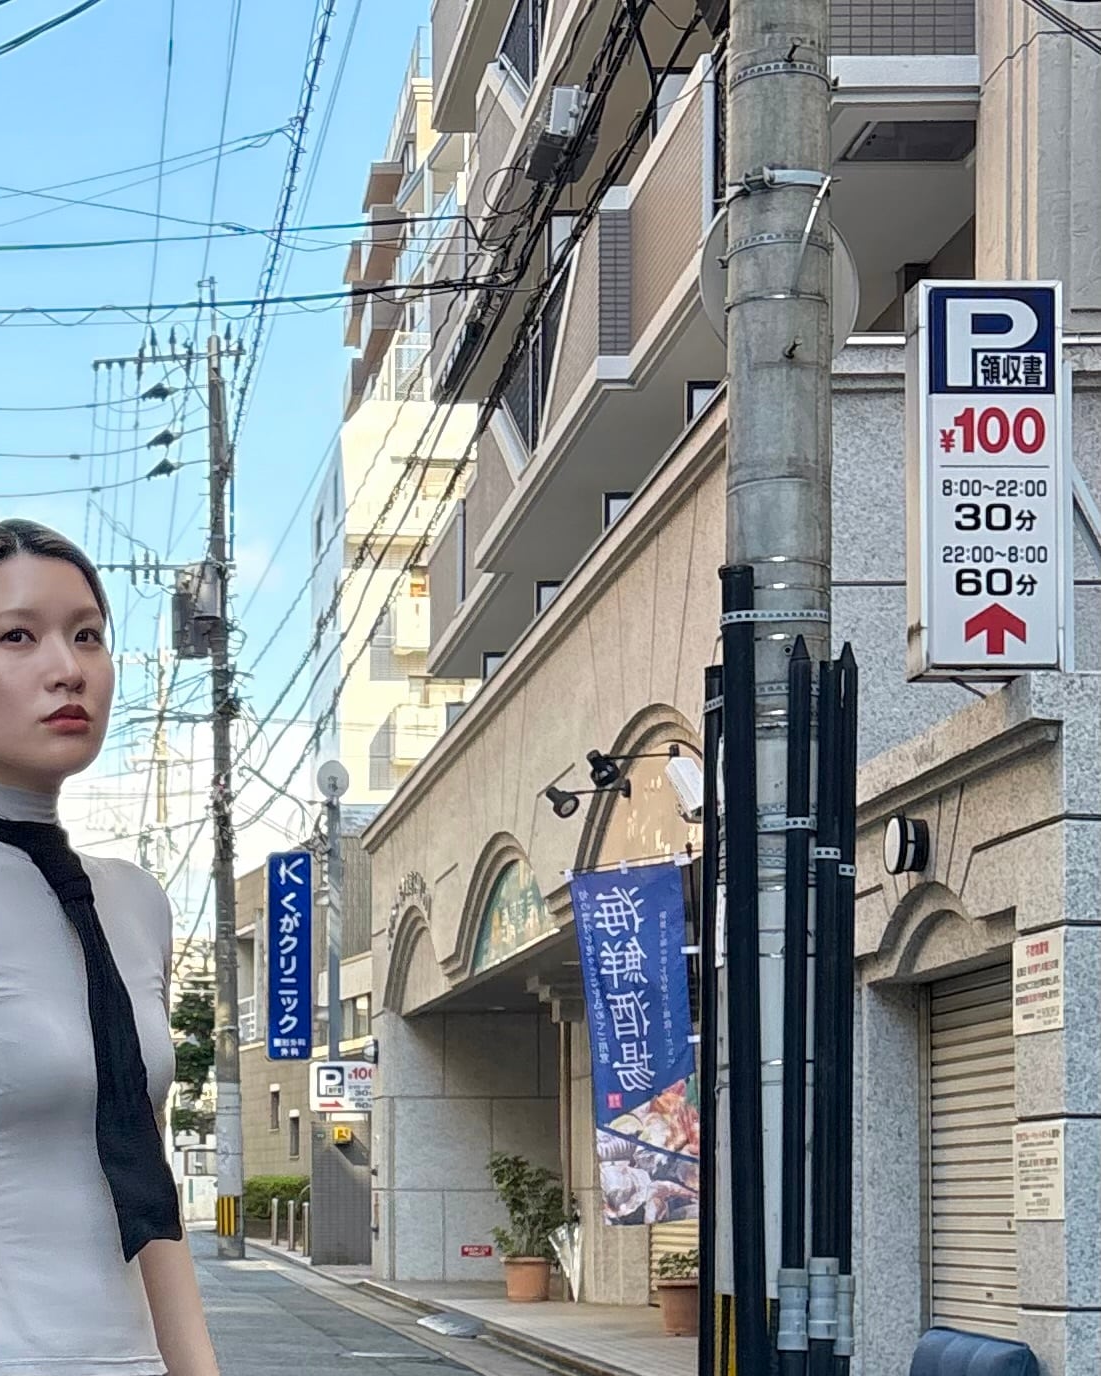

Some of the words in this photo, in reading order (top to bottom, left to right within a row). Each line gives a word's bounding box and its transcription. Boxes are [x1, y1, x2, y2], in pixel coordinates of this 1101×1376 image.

[945, 298, 1039, 387] P
[980, 354, 1043, 386] 領収書
[939, 407, 1046, 454] ¥100
[954, 503, 1037, 531] 30分
[955, 568, 1038, 596] 60分
[278, 892, 302, 1035] くがクリニック
[319, 1068, 342, 1096] P
